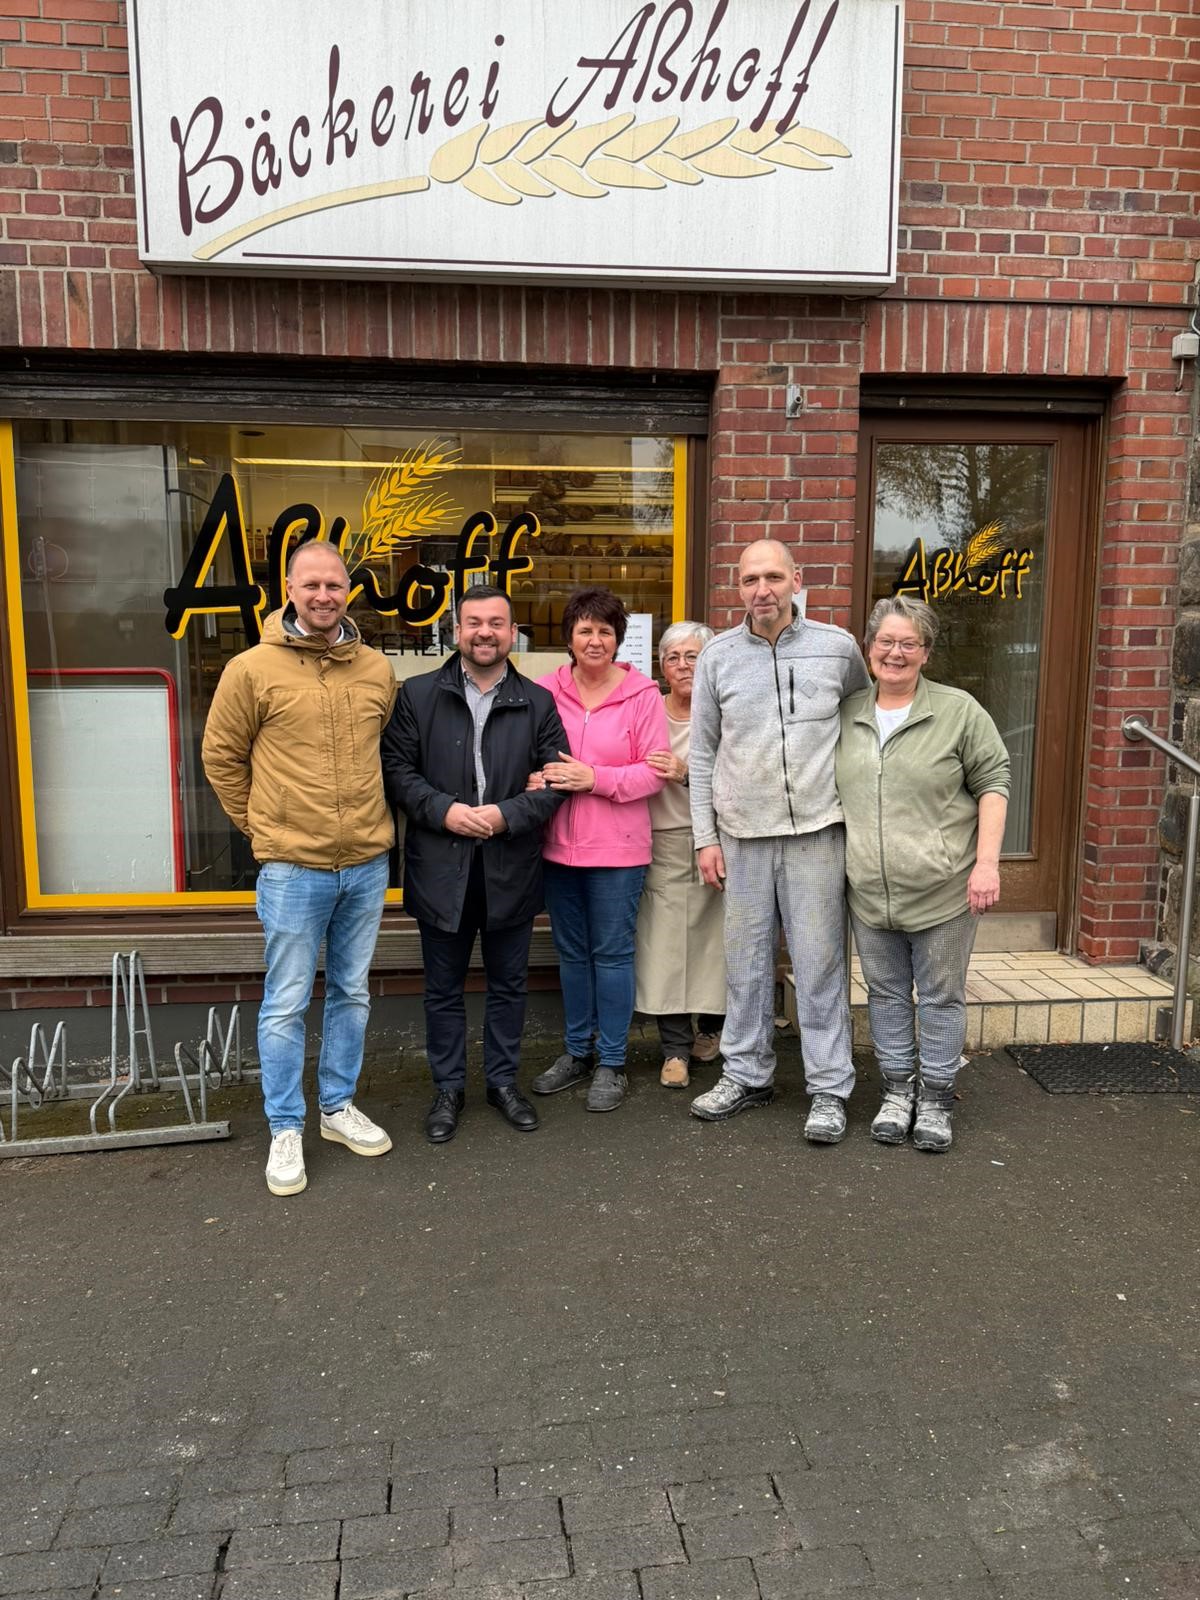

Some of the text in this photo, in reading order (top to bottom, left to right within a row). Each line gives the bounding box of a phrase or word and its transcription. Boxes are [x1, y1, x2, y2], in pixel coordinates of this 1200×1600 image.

[170, 0, 839, 236] Bäckerei Aßhoff
[892, 537, 1034, 604] Aßhoff
